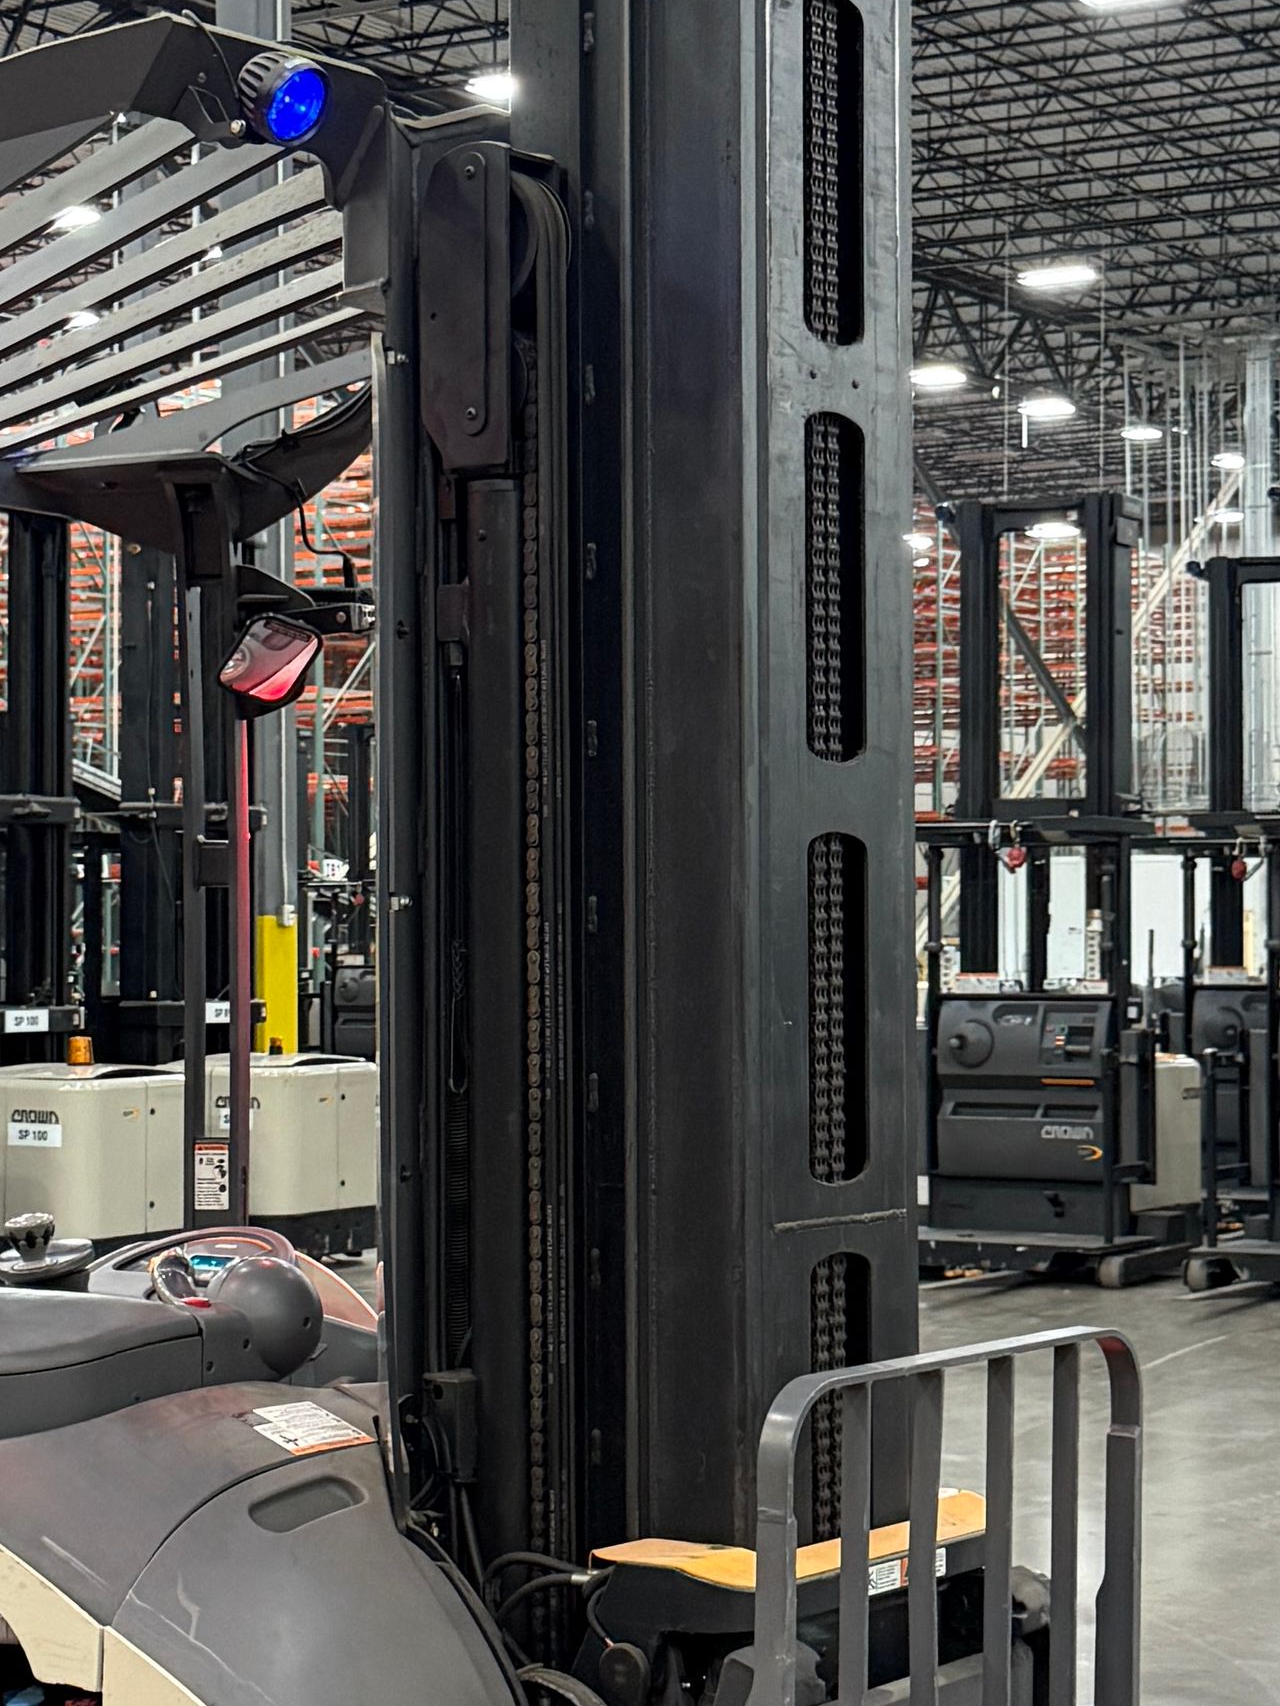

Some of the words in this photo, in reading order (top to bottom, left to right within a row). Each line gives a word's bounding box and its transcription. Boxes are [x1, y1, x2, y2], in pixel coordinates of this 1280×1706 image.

[11, 1109, 60, 1124] CROWN
[18, 1130, 30, 1140] SP
[32, 1130, 48, 1141] 100
[1040, 1125, 1094, 1140] CROWN
